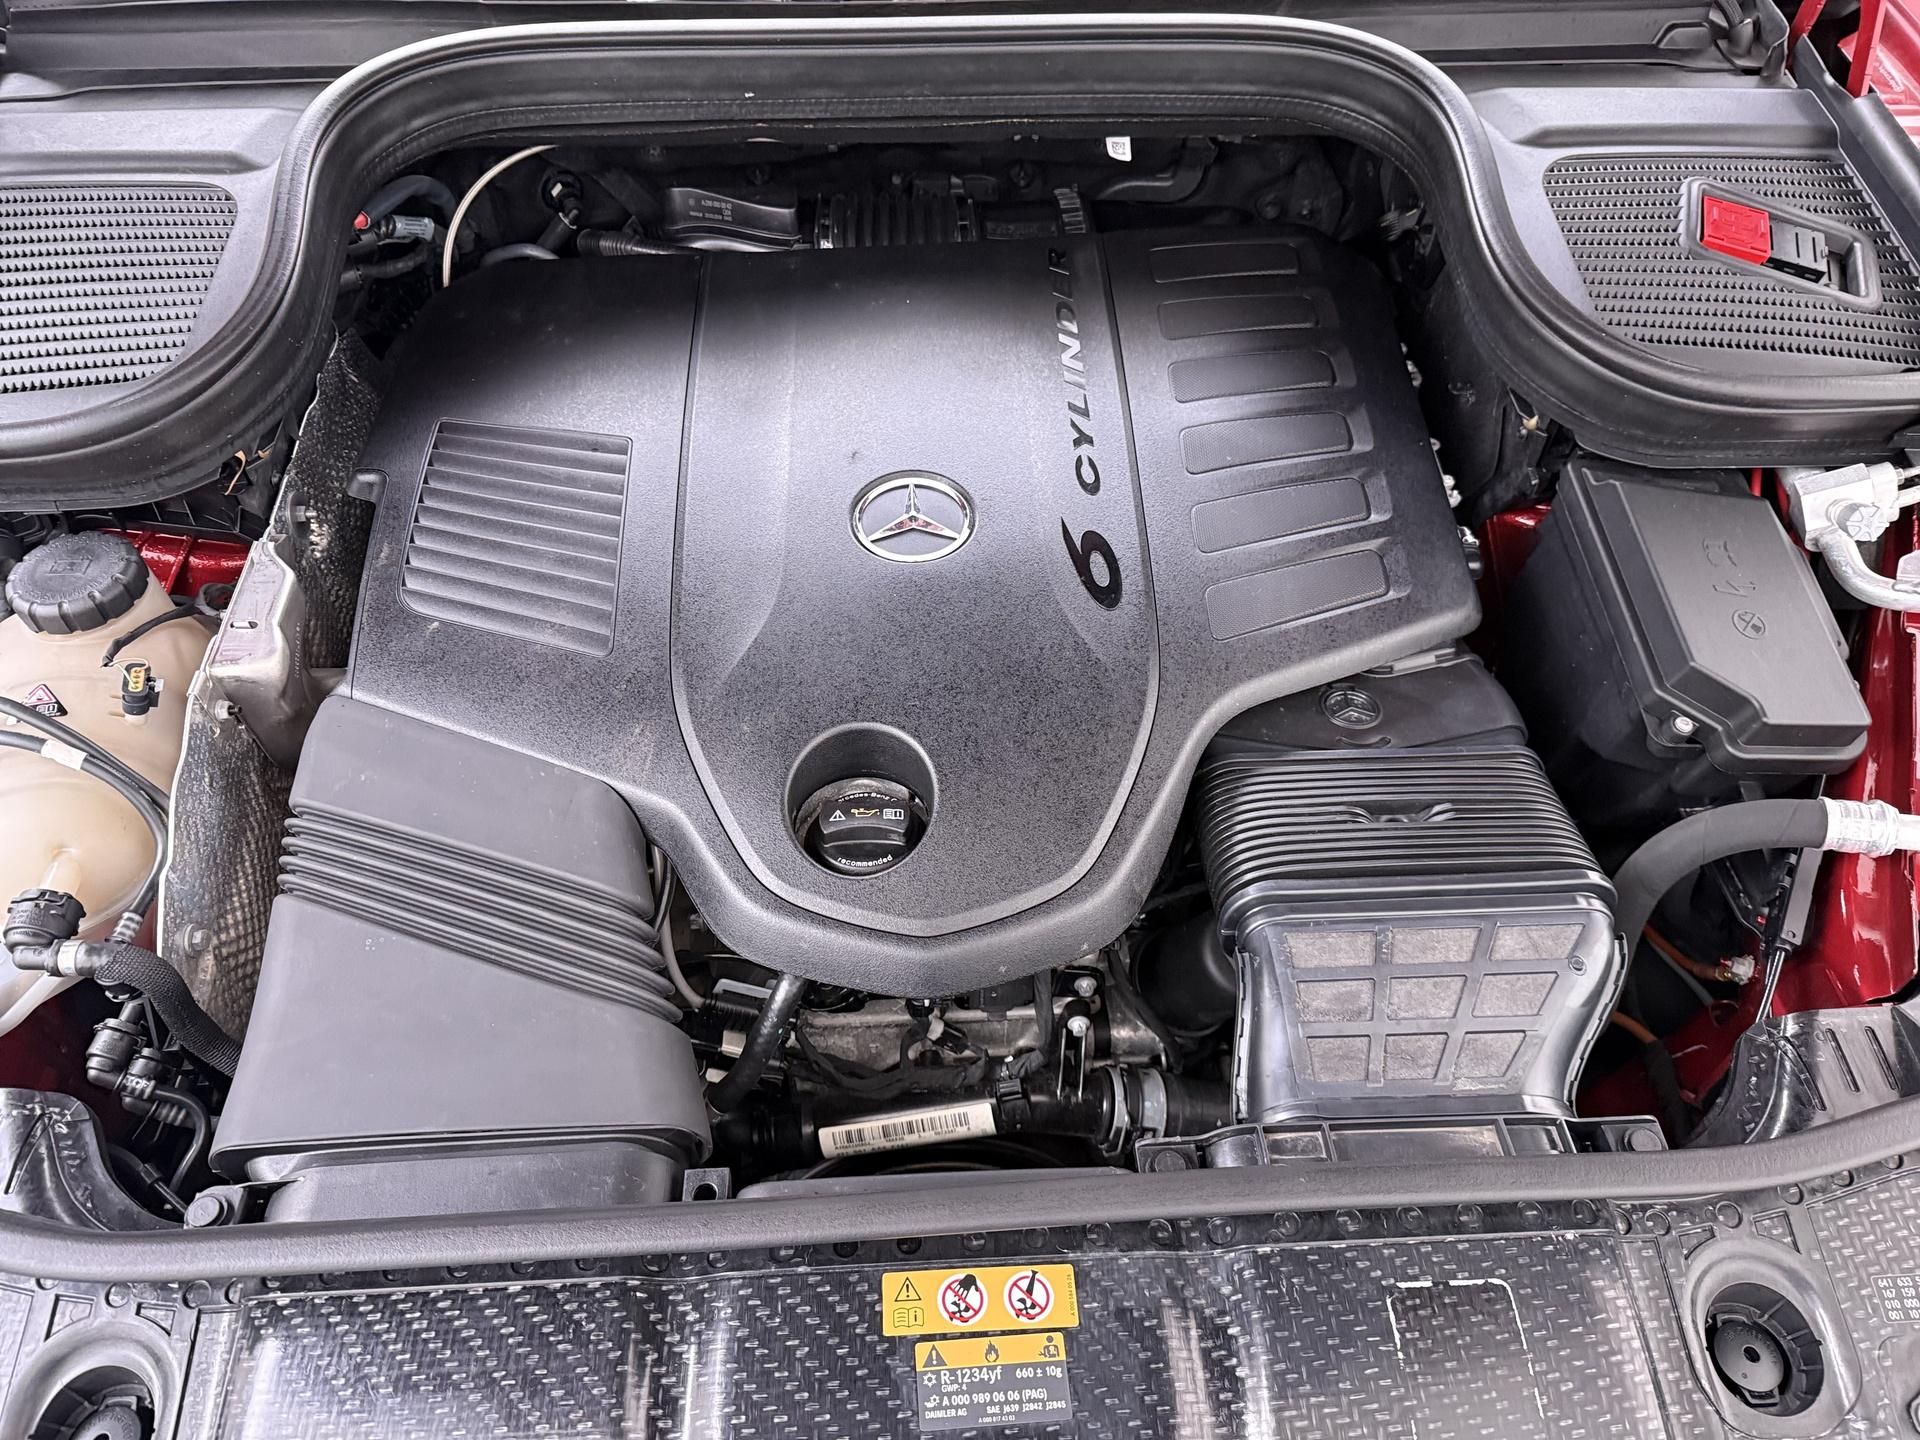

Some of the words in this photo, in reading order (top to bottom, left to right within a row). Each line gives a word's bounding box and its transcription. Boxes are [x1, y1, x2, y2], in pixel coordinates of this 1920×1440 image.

[1048, 248, 1101, 496] CYLINDER
[1061, 516, 1122, 612] 6
[837, 854, 893, 867] recommended
[1878, 1278, 1893, 1288] 641
[1897, 1276, 1913, 1287] 633
[1882, 1288, 1896, 1298] 167
[1901, 1287, 1916, 1297] 159
[1885, 1299, 1901, 1309] 010
[1904, 1298, 1920, 1308] 000
[1888, 1310, 1904, 1320] 001
[940, 1366, 1002, 1385] R-1234yf
[1016, 1367, 1034, 1379] 660
[1046, 1365, 1063, 1378] 10g
[941, 1384, 961, 1392] GWP:
[962, 1383, 967, 1391] 4
[942, 1396, 950, 1406] A
[951, 1394, 970, 1405] 000
[972, 1392, 991, 1404] 989
[992, 1391, 1006, 1402] 06
[1007, 1390, 1020, 1401] 06
[1022, 1388, 1048, 1402] (PAG)
[925, 1409, 957, 1419] DAIMLER
[957, 1408, 968, 1416] AG
[986, 1405, 1000, 1414] SAE
[1003, 1403, 1020, 1414] J639
[1022, 1401, 1043, 1412] J2842
[1045, 1400, 1067, 1411] J2845
